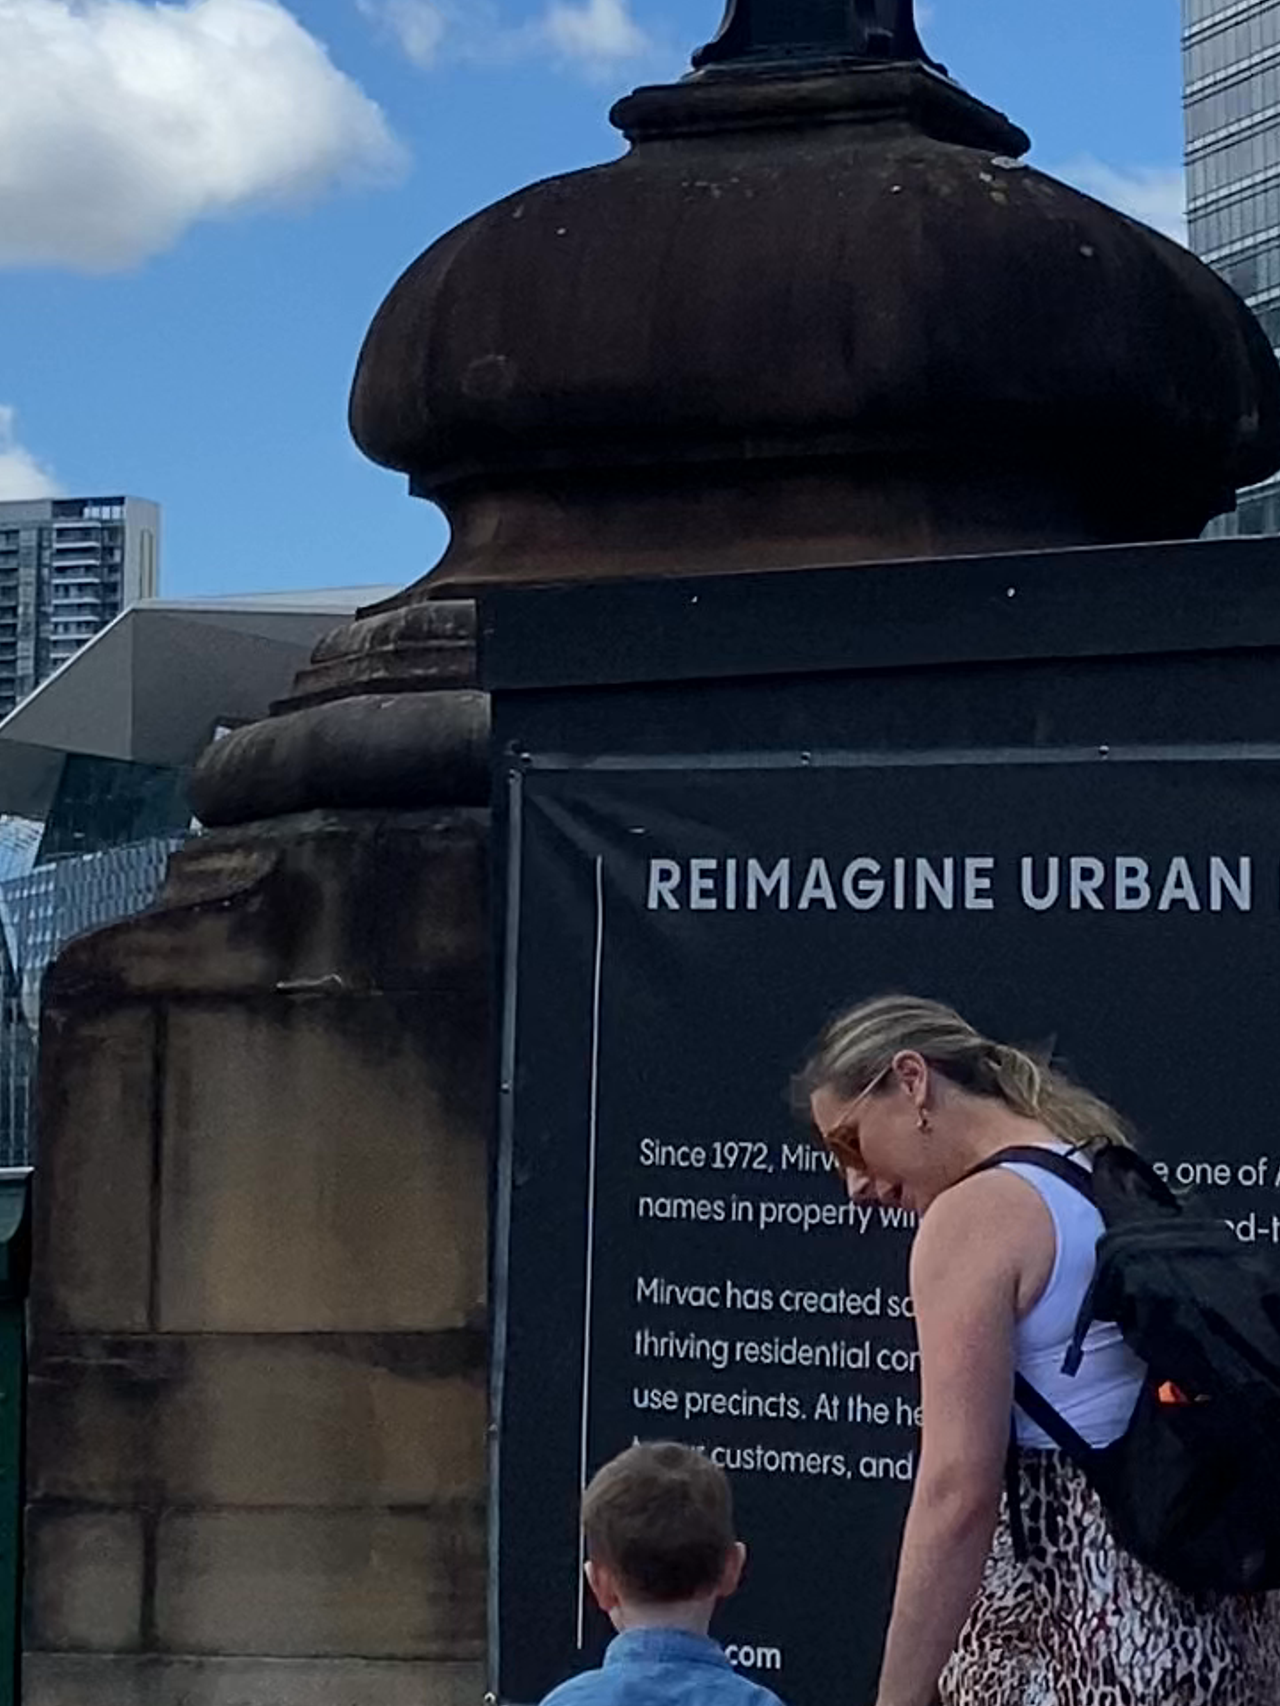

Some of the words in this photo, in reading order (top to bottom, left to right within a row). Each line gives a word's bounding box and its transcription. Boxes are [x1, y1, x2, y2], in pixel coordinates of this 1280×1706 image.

[646, 857, 995, 910] REIMAGINE
[1021, 856, 1252, 911] URBAN
[639, 1137, 706, 1168] Since
[711, 1140, 774, 1174] 1972,
[781, 1143, 839, 1173] Mirv
[1176, 1161, 1232, 1185] one
[1237, 1156, 1269, 1186] of
[638, 1195, 726, 1222] names
[731, 1193, 754, 1223] in
[759, 1199, 872, 1235] property
[636, 1275, 721, 1309] Mirvac
[725, 1280, 774, 1311] has
[778, 1286, 882, 1317] created
[634, 1328, 729, 1369] thriving
[734, 1336, 871, 1370] residential
[632, 1386, 679, 1411] use
[684, 1388, 808, 1420] precincts.
[813, 1391, 840, 1422] At
[846, 1393, 890, 1426] the
[711, 1445, 853, 1480] customers,
[858, 1451, 914, 1481] and
